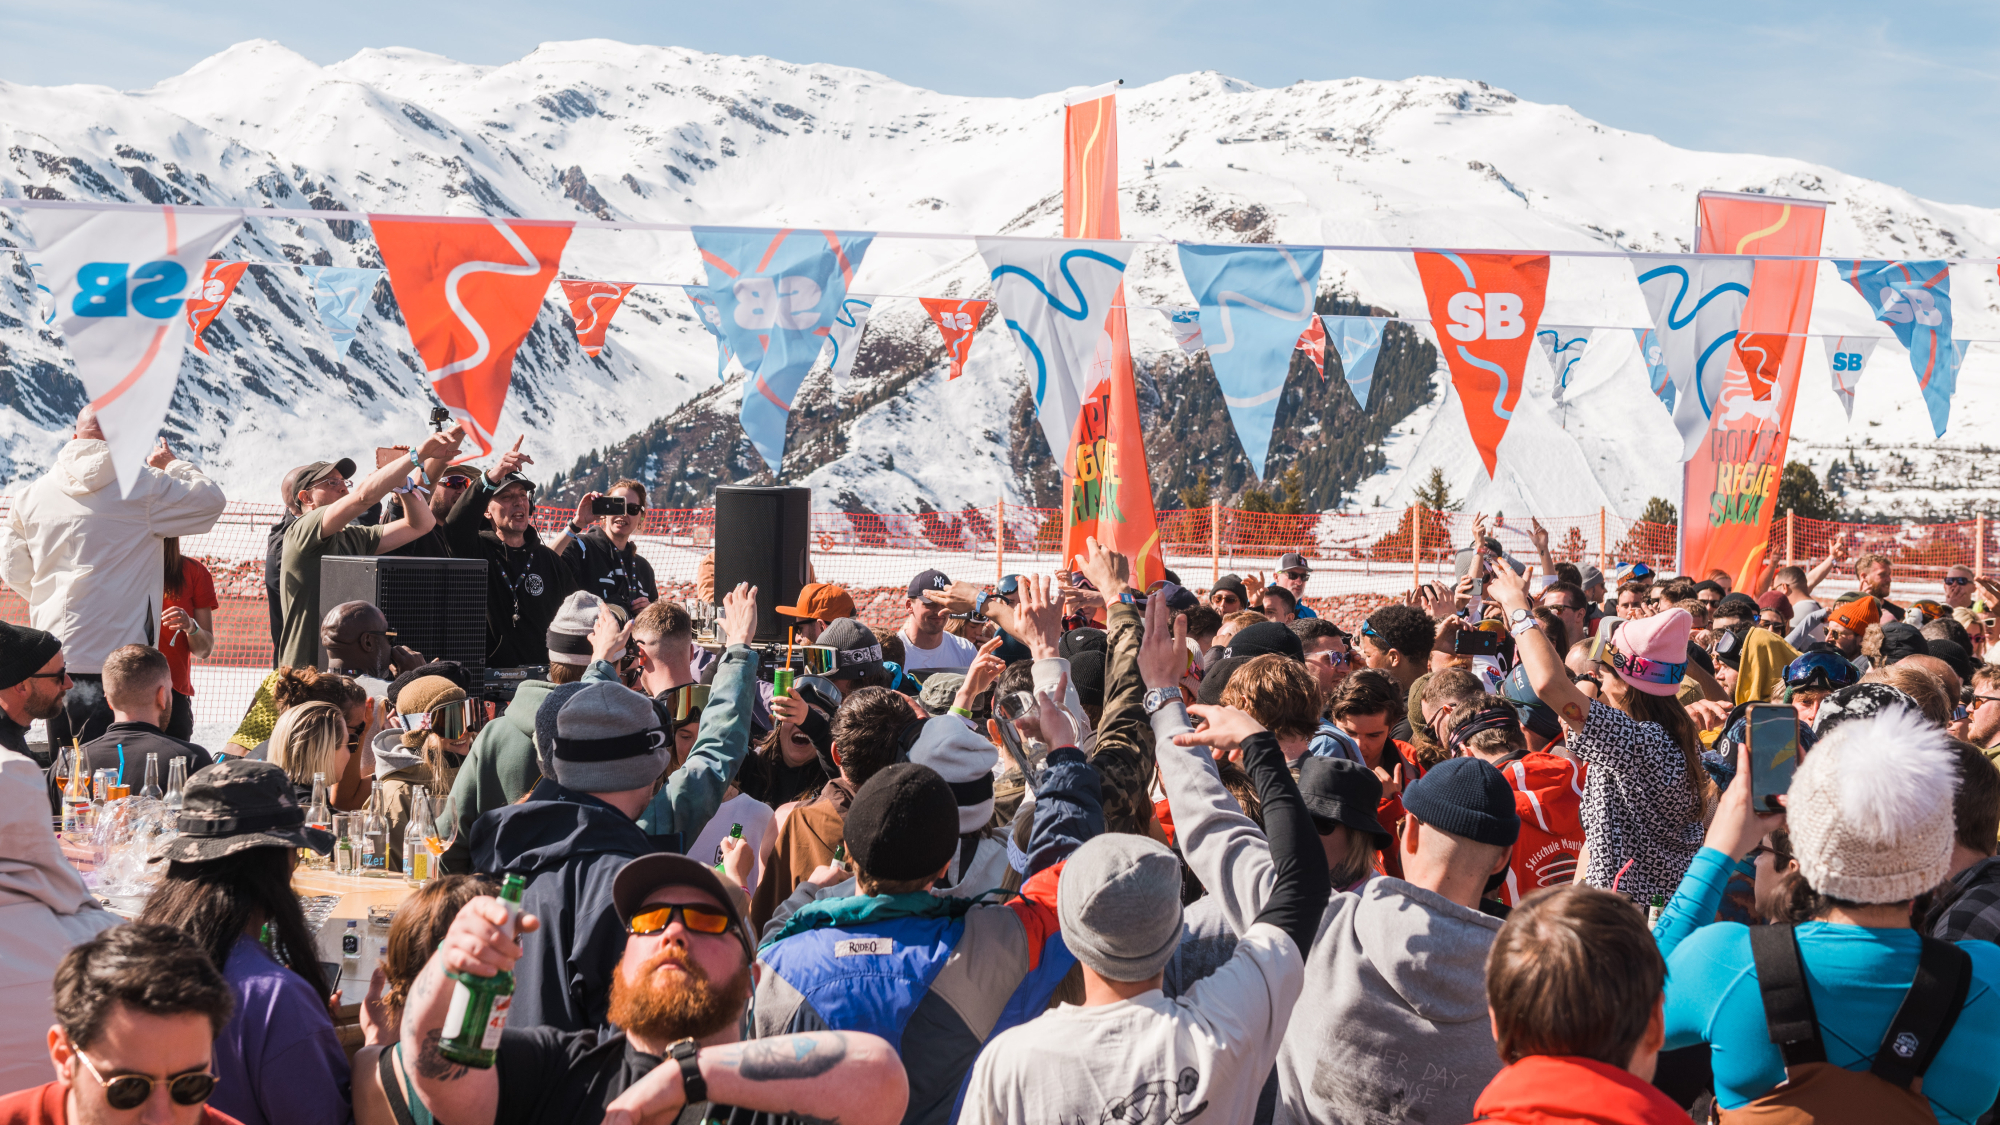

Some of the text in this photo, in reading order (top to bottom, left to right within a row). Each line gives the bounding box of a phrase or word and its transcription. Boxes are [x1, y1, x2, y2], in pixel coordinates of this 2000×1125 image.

[1445, 291, 1526, 342] SB
[1879, 286, 1943, 326] SB
[1832, 352, 1863, 371] SB
[1525, 841, 1561, 871] Skischule
[849, 941, 877, 953] RODEO
[1421, 1062, 1468, 1089] DAY
